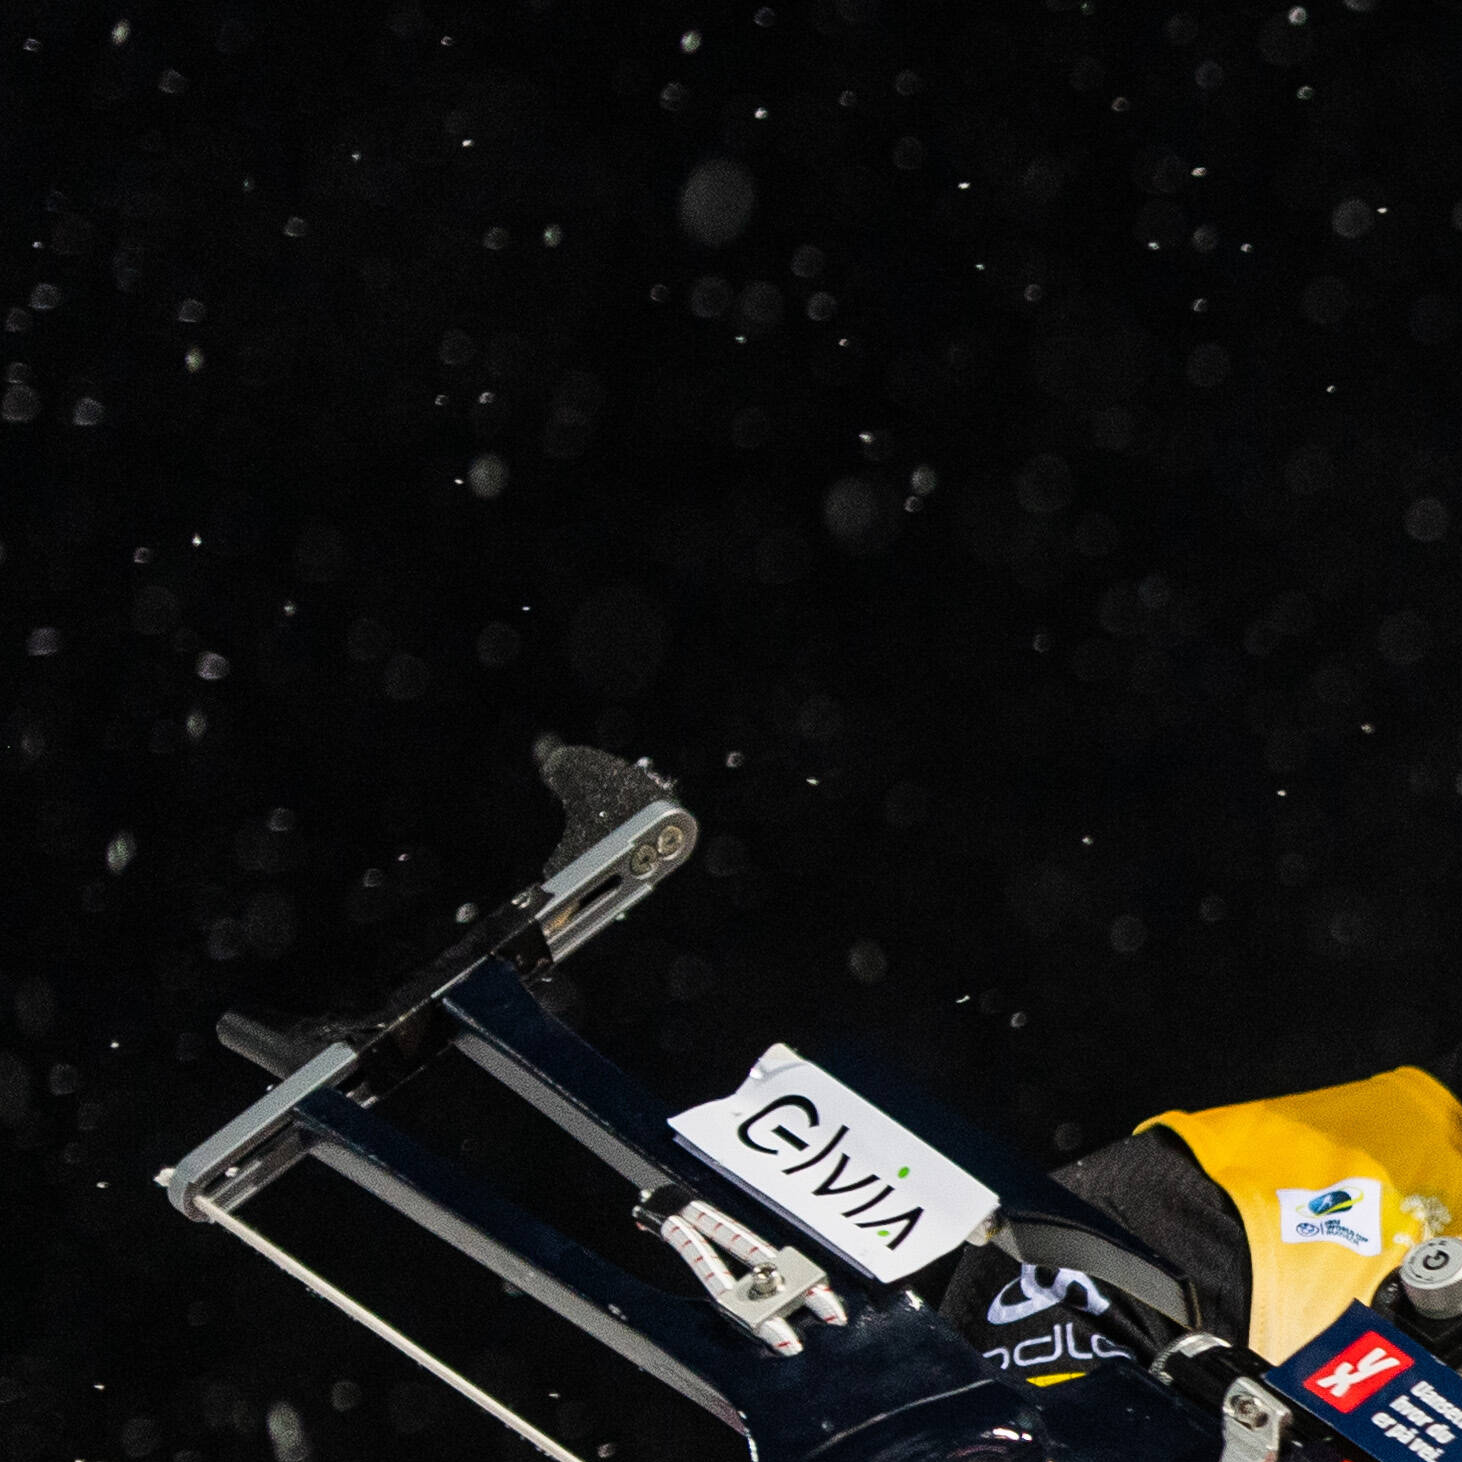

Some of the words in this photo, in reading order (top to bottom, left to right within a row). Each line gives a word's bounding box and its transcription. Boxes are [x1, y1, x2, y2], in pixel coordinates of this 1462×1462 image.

[1371, 1412, 1396, 1429] er
[1389, 1395, 1435, 1427] hvor
[1425, 1423, 1457, 1444] du
[1383, 1423, 1420, 1445] på
